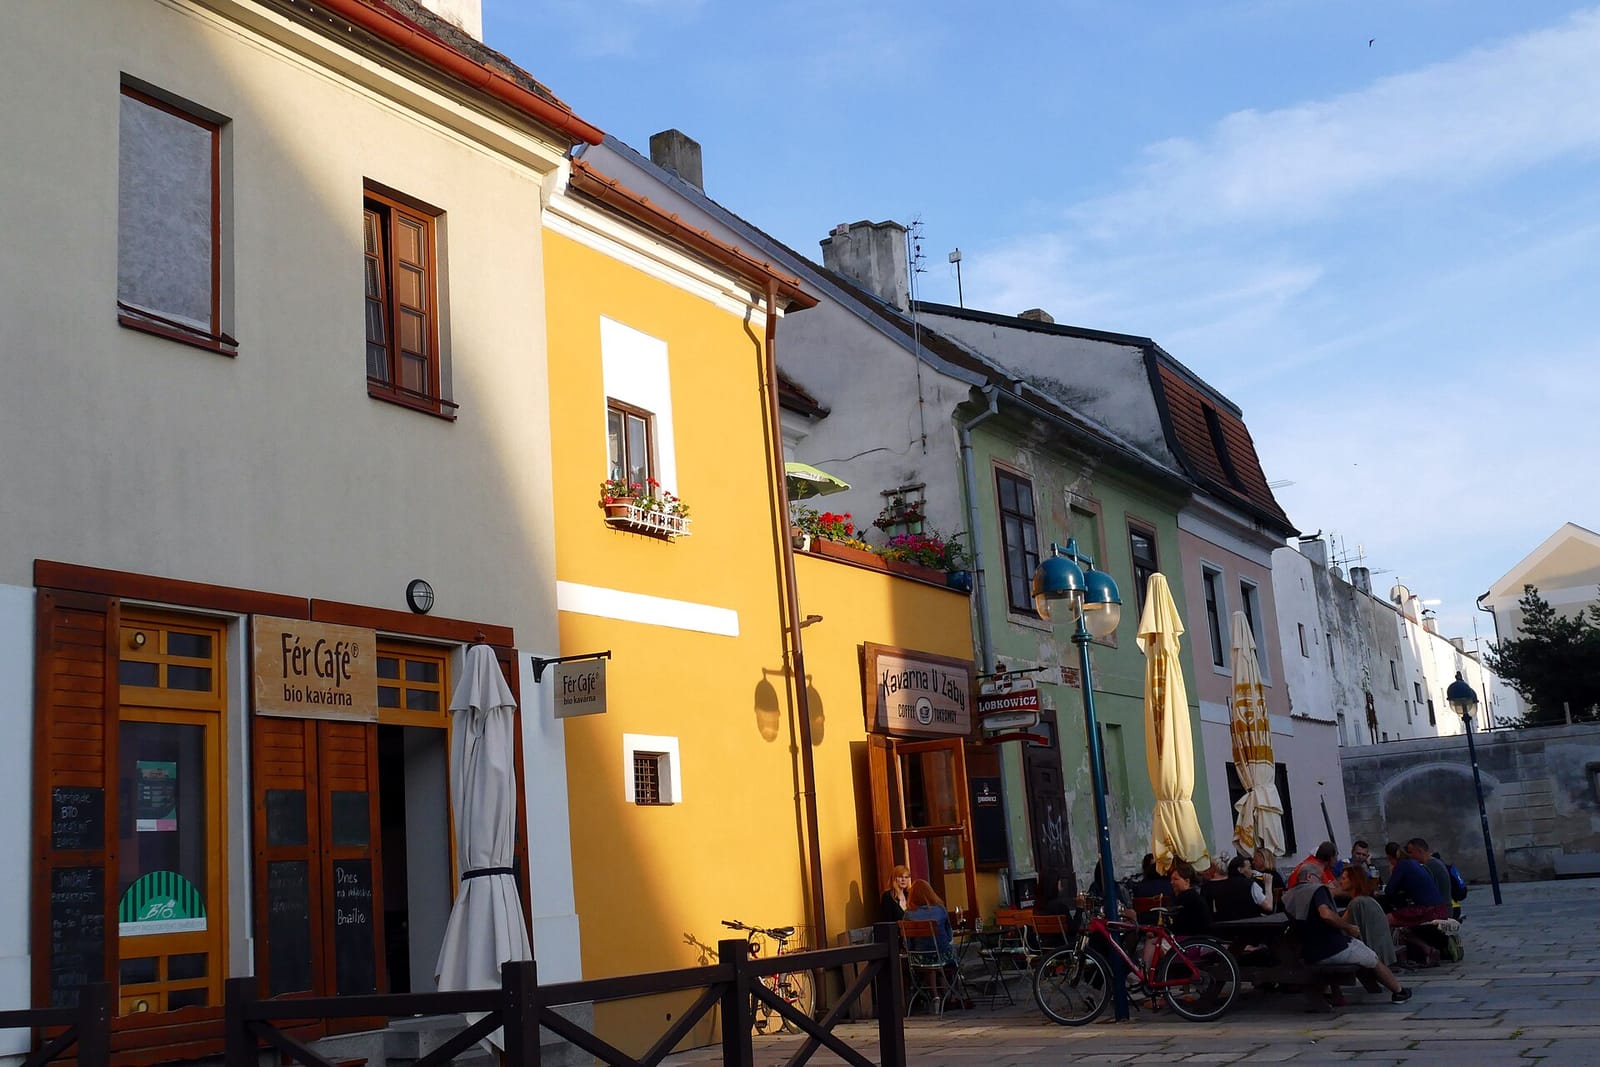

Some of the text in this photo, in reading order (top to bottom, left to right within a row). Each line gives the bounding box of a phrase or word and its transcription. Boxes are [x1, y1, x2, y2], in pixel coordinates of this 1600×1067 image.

[281, 632, 311, 679] Fér
[284, 683, 353, 706] bio kavárna
[563, 675, 576, 695] Fér
[931, 668, 938, 693] U
[941, 672, 965, 712] Žáby
[563, 695, 596, 705] bio kavárna
[978, 695, 1037, 712] LOBKOWICZ
[897, 703, 915, 720] COFFEE
[336, 866, 358, 884] Dnes
